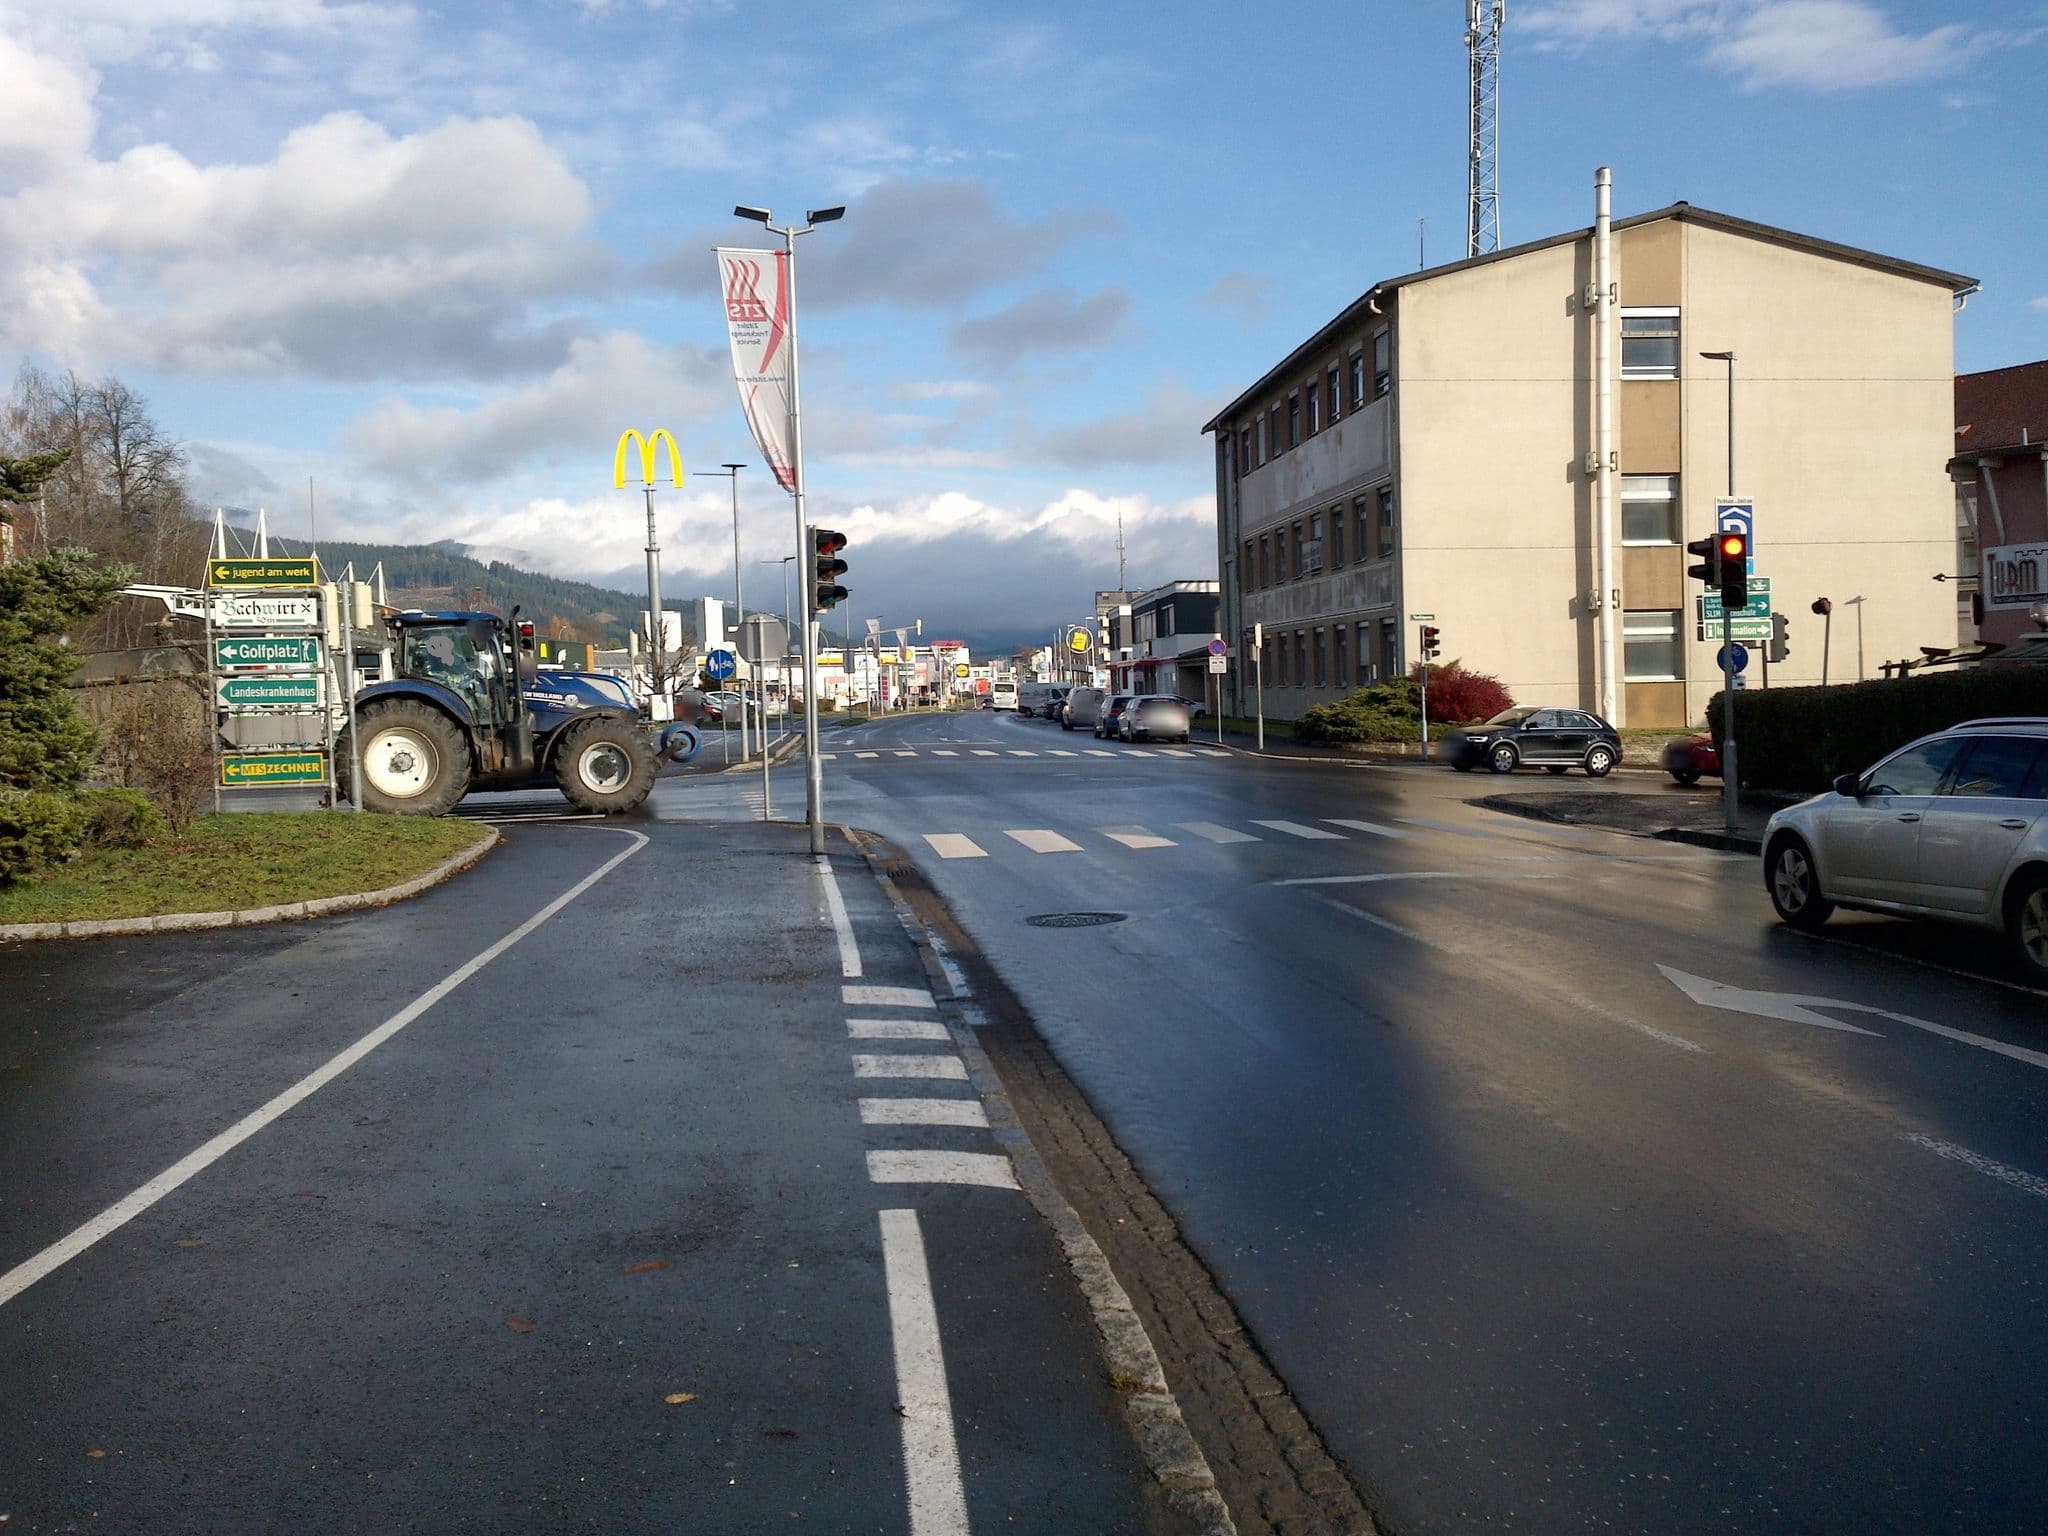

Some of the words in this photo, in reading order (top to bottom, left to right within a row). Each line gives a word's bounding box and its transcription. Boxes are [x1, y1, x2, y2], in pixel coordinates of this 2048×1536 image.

[232, 567, 265, 579] jugend
[266, 568, 283, 577] am
[285, 567, 310, 577] werk
[221, 600, 297, 616] Bachwirt
[1717, 624, 1757, 635] Inrmation
[239, 643, 299, 661] Golfplatz
[230, 685, 316, 698] Landeskrankenhaus
[242, 763, 264, 775] MTS
[266, 763, 320, 774] ZECHNER
